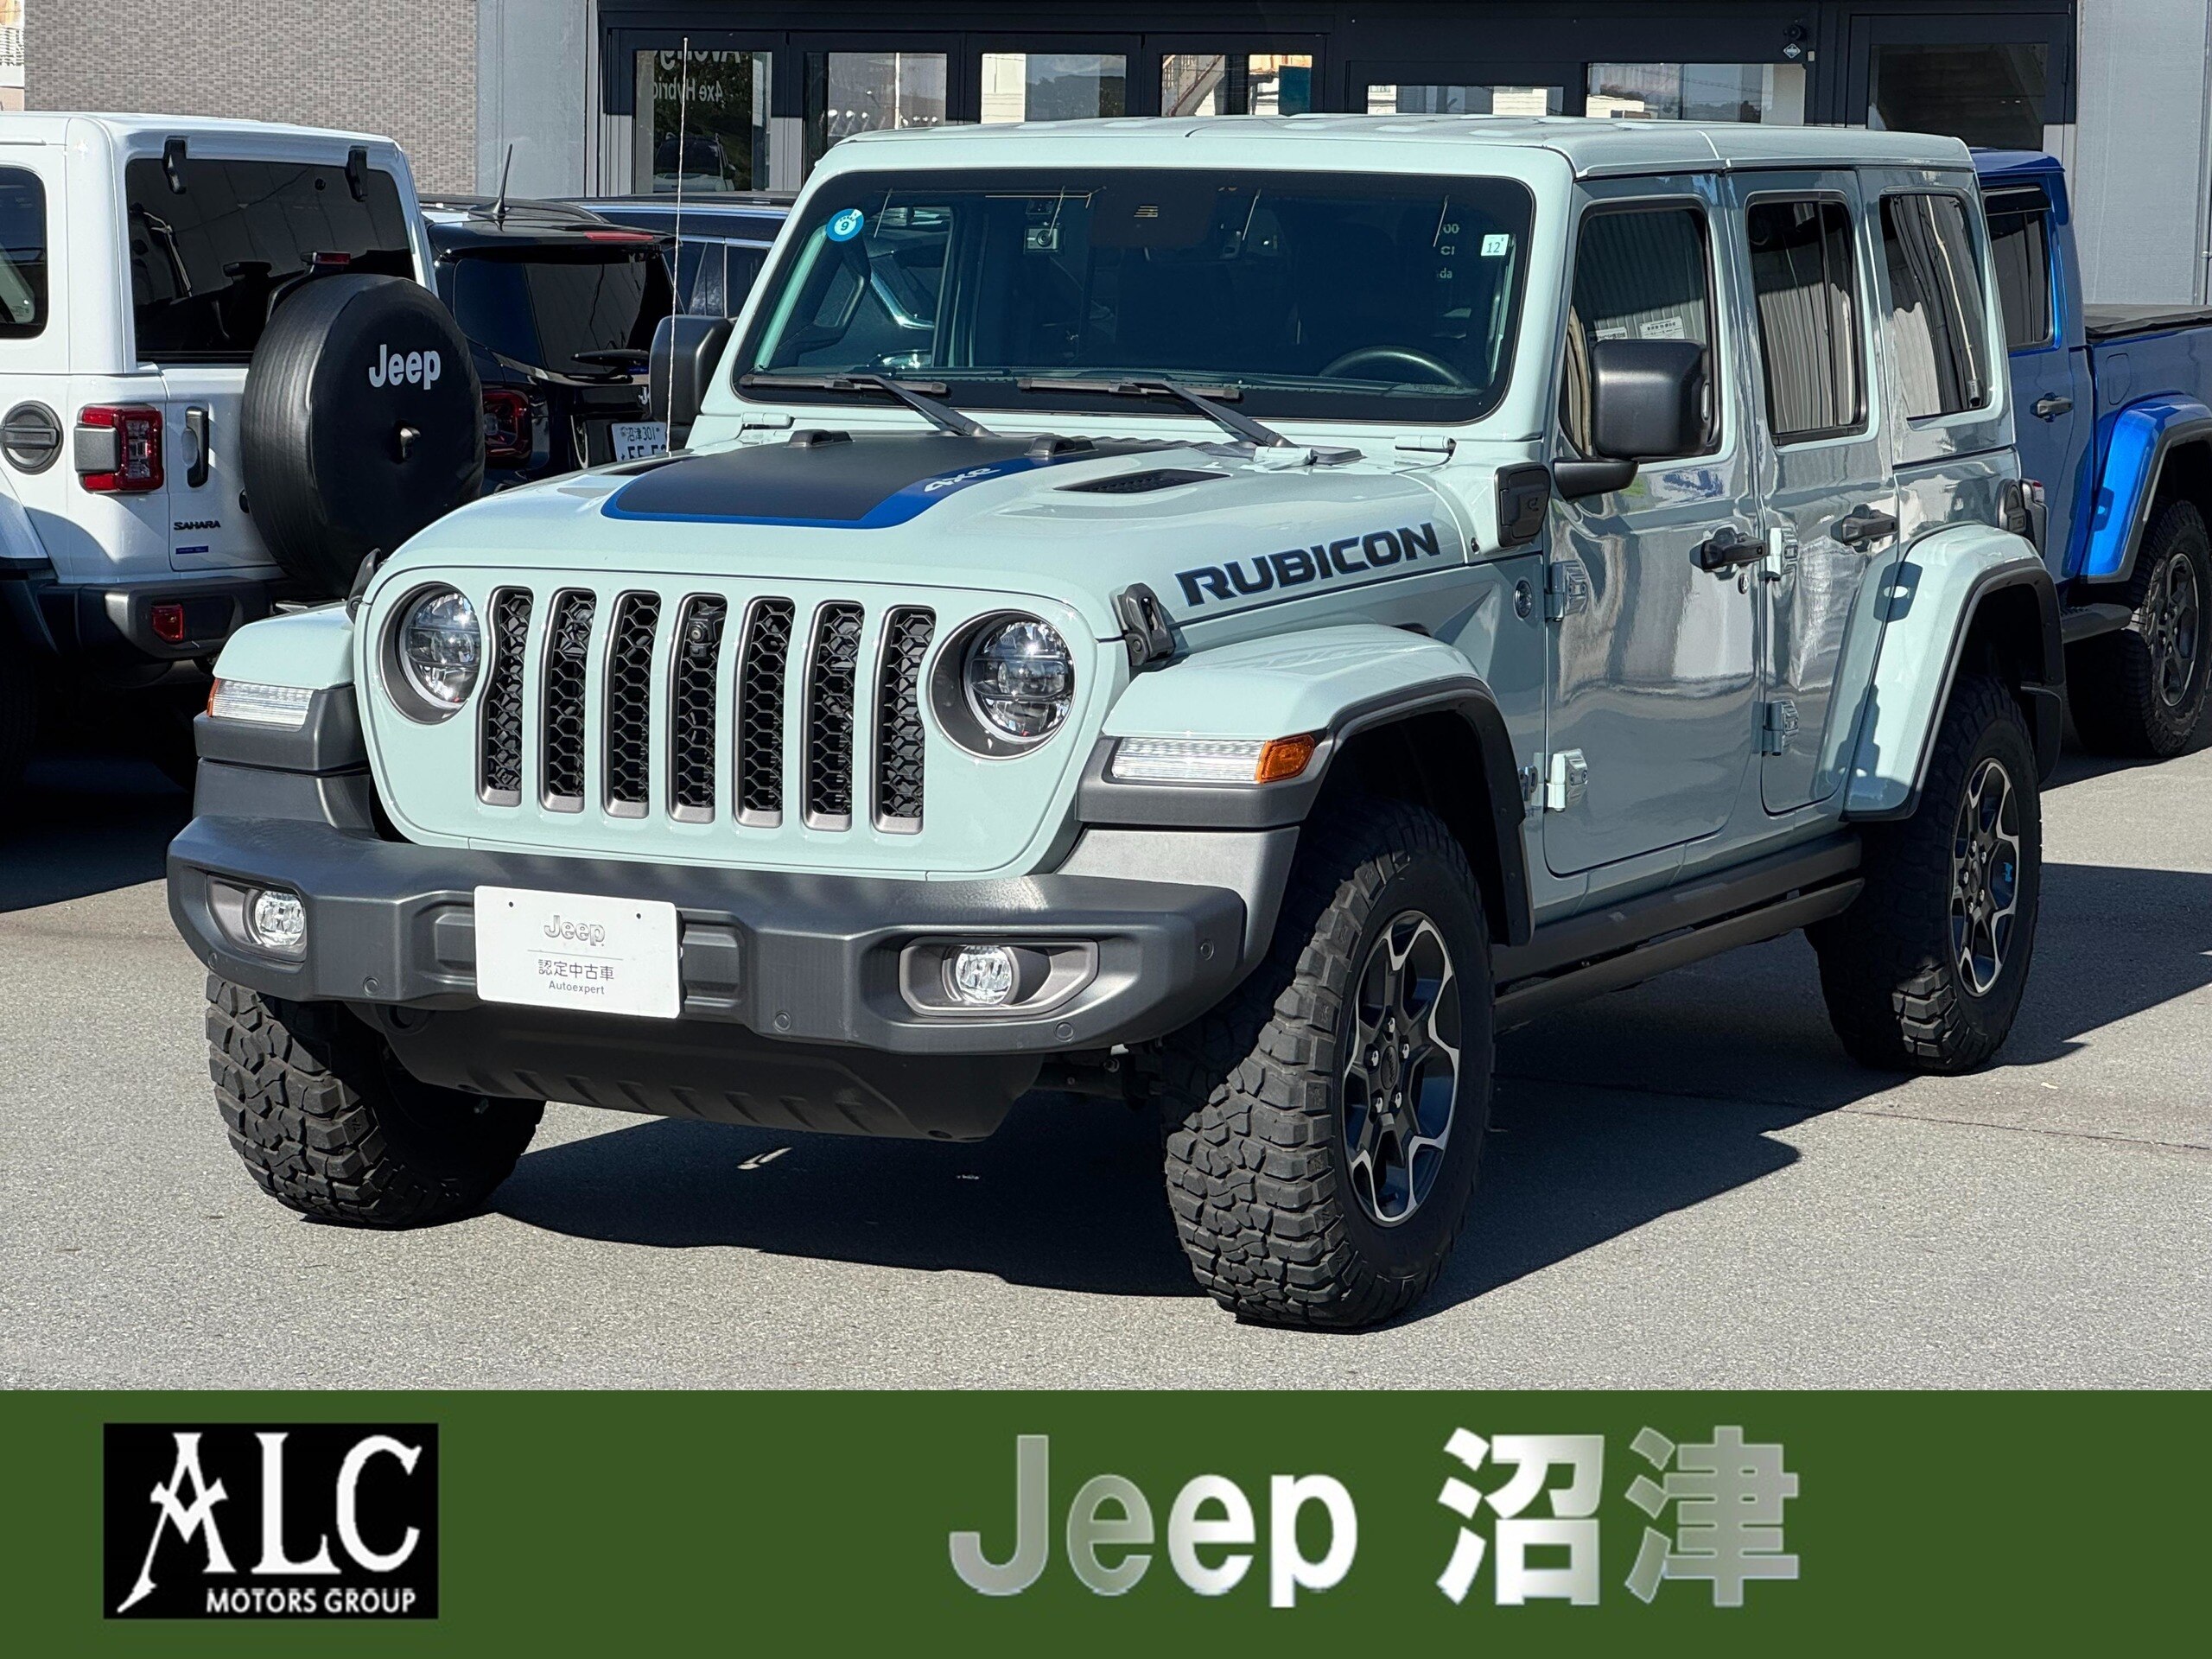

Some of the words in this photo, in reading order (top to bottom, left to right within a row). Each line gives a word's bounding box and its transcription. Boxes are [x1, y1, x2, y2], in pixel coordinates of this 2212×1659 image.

[841, 221, 849, 231] 9
[1486, 242, 1501, 253] 12
[369, 344, 441, 391] Jeep
[643, 426, 657, 441] 301
[173, 520, 221, 531] SAHARA
[1174, 522, 1441, 607] RUBICON
[543, 915, 606, 946] Jeep
[537, 959, 614, 981] 認定中古車
[549, 980, 605, 995] Autoexpert
